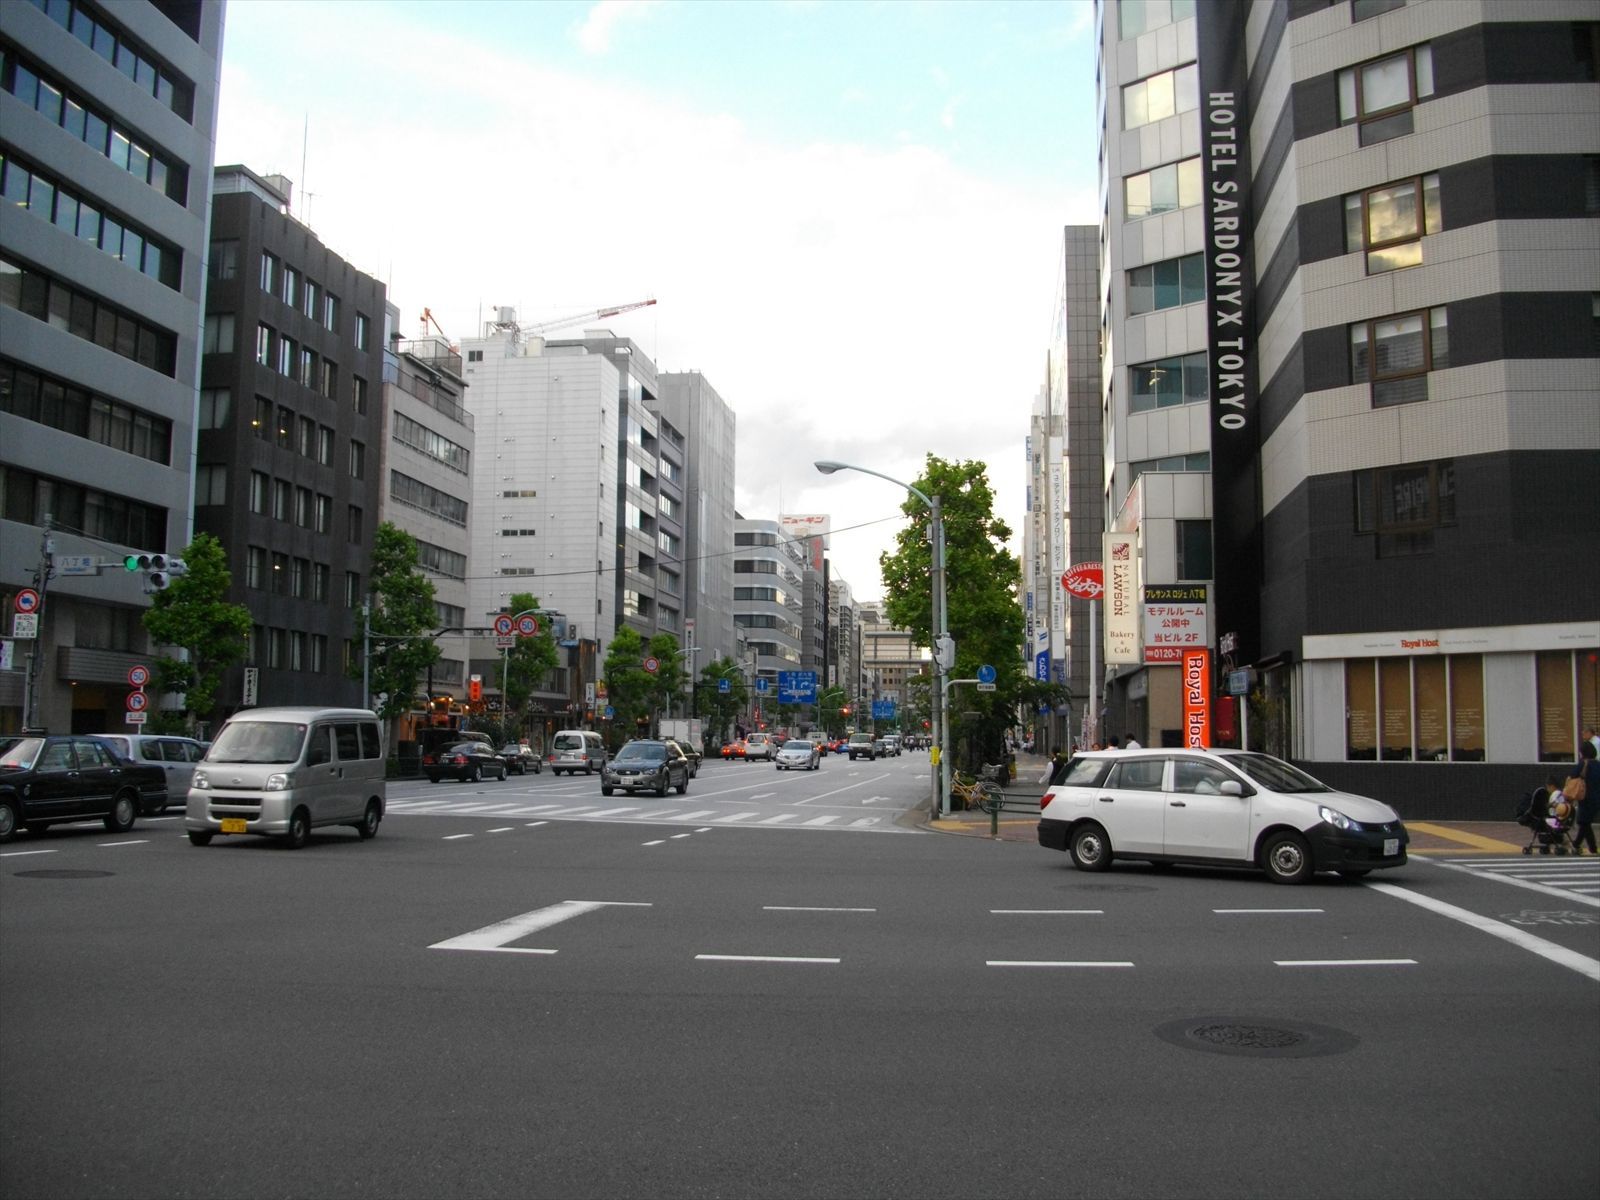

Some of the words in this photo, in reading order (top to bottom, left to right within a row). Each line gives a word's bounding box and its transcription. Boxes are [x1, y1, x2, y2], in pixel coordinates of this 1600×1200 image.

[1209, 92, 1236, 171] HOTEL
[1212, 181, 1243, 326] SARDONYX
[1217, 337, 1246, 429] TOKYO
[1064, 563, 1103, 580] COFFEE&REST
[1113, 564, 1122, 617] LAWSON
[1146, 589, 1171, 599] プレサンス
[1147, 607, 1204, 616] モデルルーム
[522, 620, 533, 630] 50
[1161, 618, 1190, 628] 公開中
[1110, 630, 1135, 639] Bakery
[1154, 633, 1182, 643] 当ビル
[1184, 633, 1199, 642] 2F
[1400, 639, 1421, 649] Royal
[1422, 638, 1440, 647] Host
[1114, 646, 1131, 654] Cafe
[1186, 655, 1205, 705] Royal
